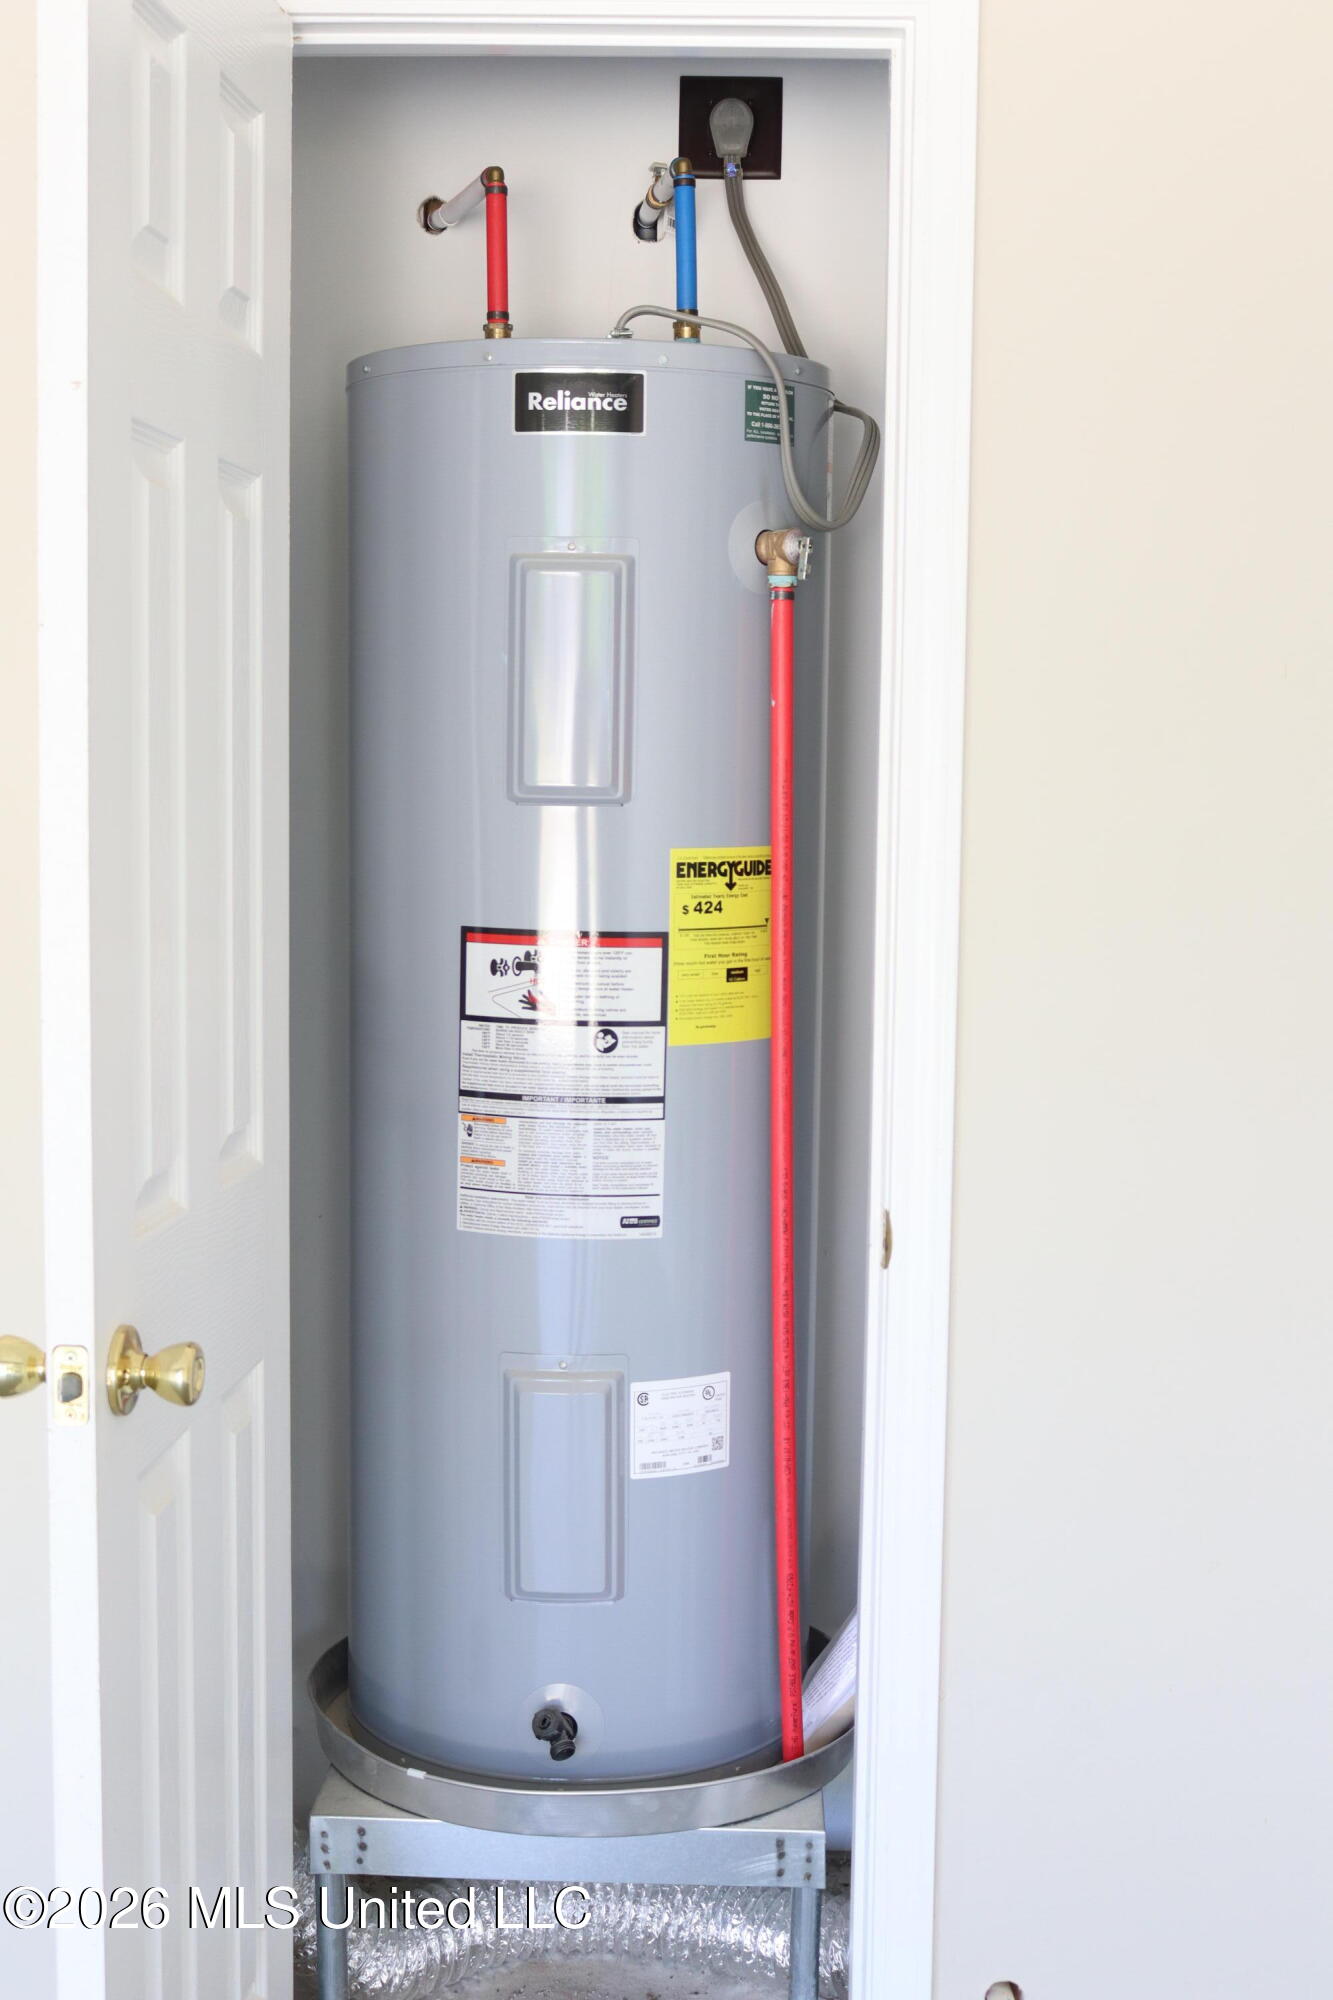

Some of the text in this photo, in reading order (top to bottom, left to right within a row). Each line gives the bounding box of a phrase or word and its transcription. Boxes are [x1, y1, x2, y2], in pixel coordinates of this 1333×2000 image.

[528, 390, 628, 411] Reliance
[676, 860, 772, 878] ENERGYGUIDE
[693, 900, 723, 914] 424
[521, 1095, 559, 1103] IMPORTANT
